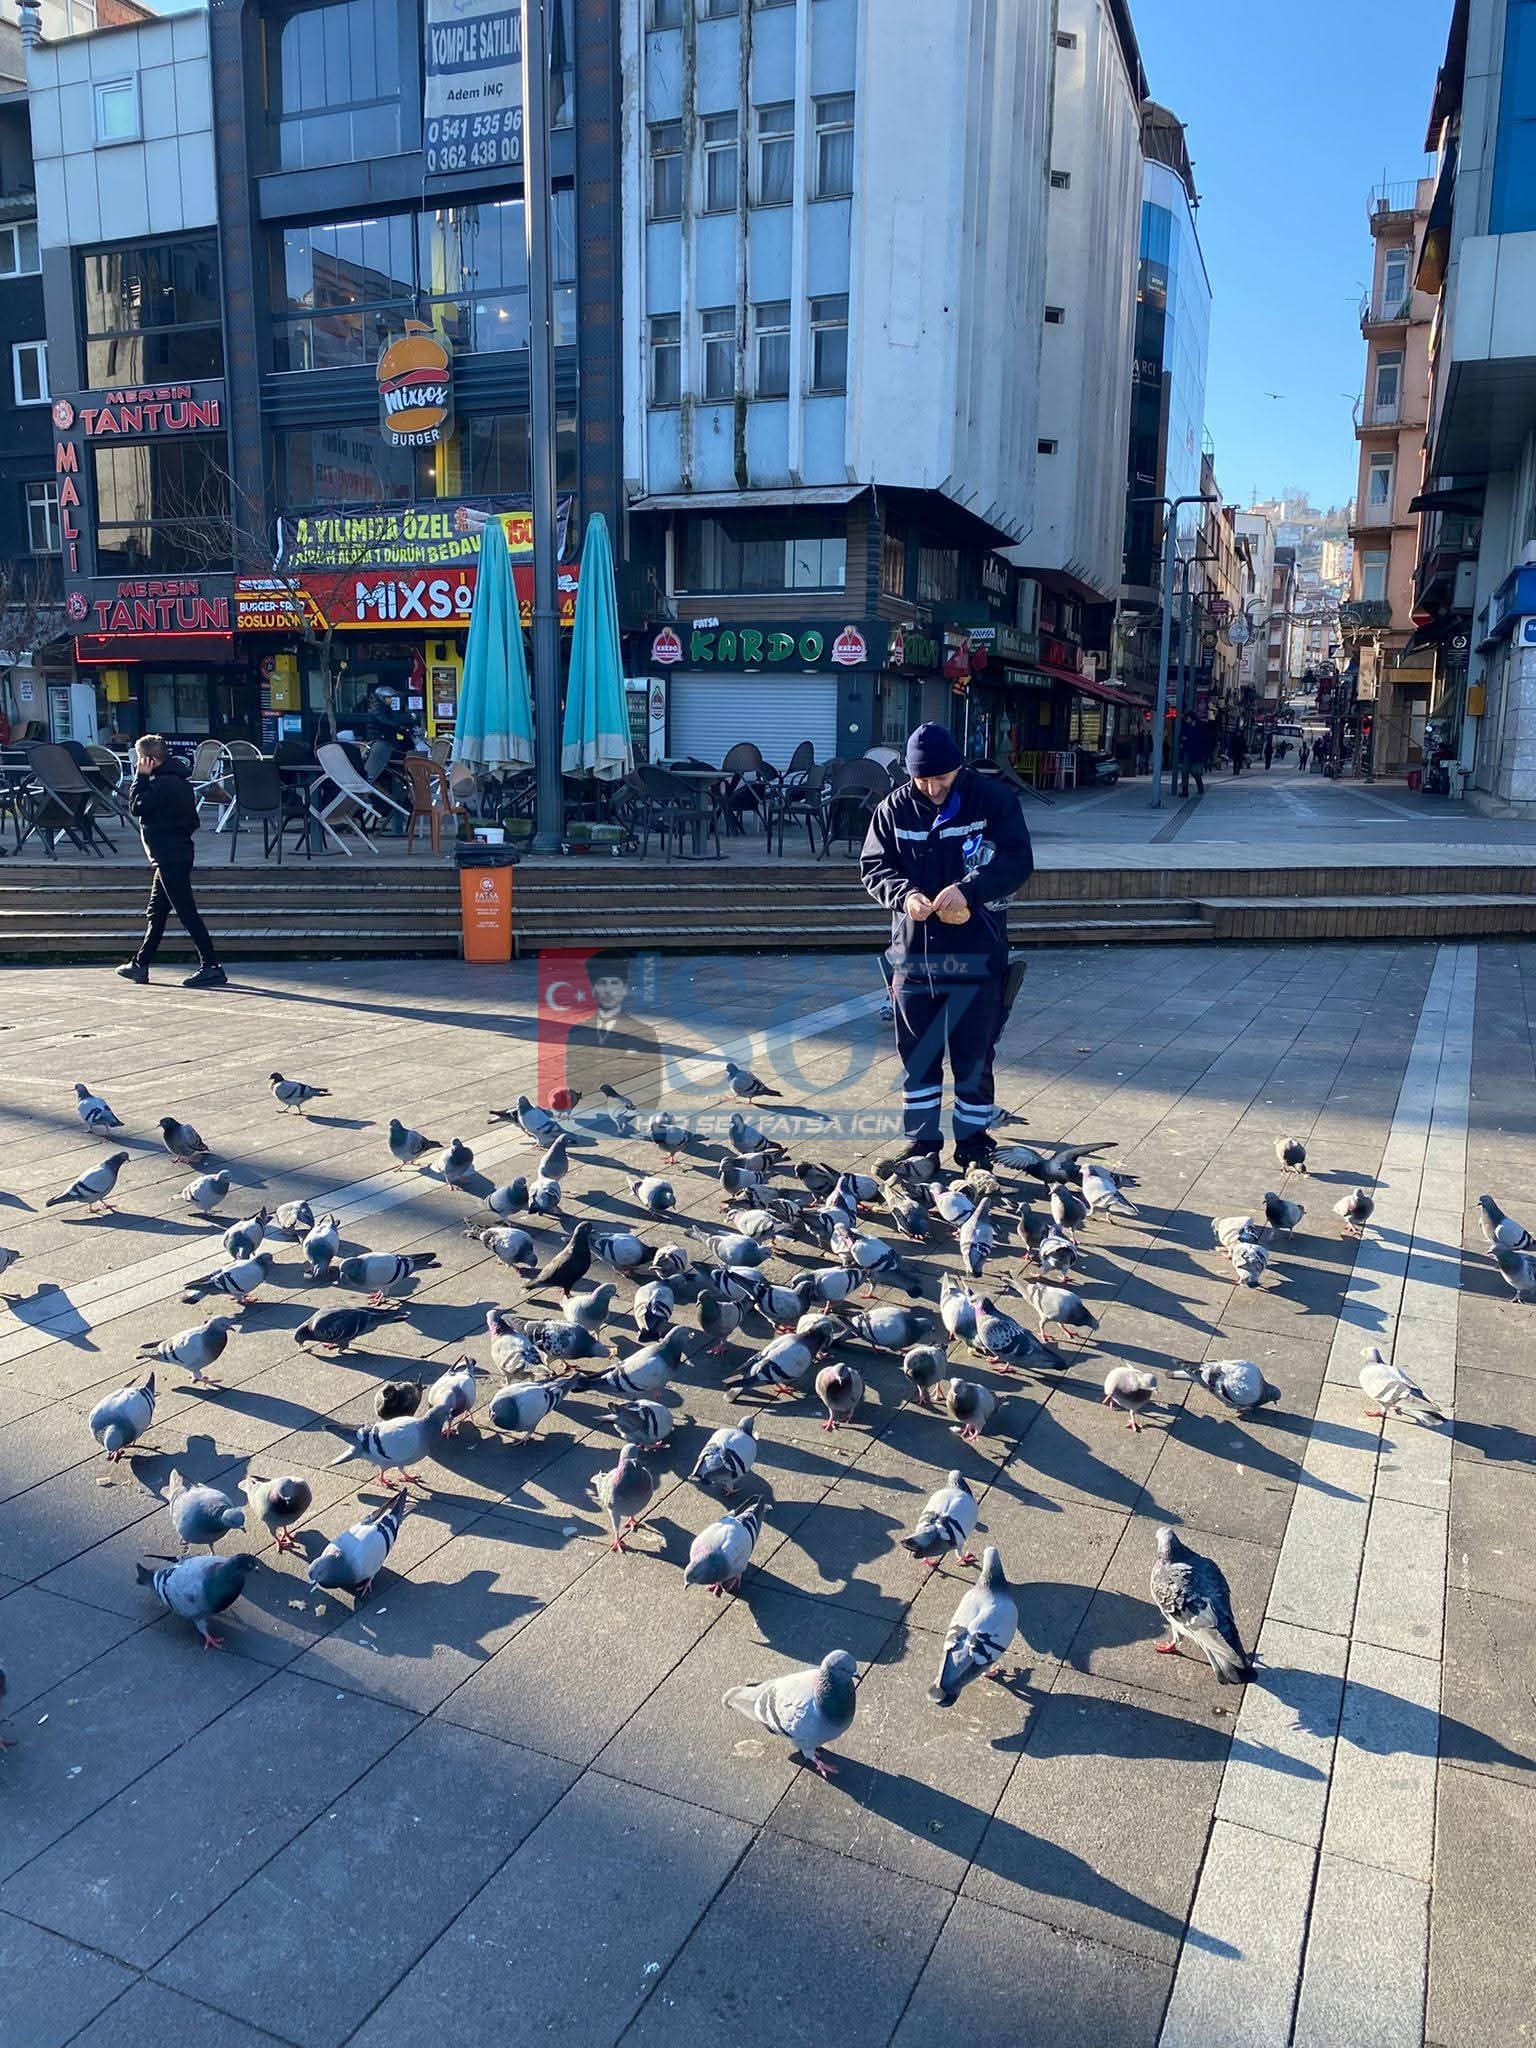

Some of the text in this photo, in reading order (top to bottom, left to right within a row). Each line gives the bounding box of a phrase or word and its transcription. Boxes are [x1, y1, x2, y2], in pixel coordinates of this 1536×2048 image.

[432, 15, 521, 65] KOMPLE SATILIK
[447, 82, 503, 101] Adem İNÇ
[428, 109, 522, 143] 0 541 535 96
[427, 136, 519, 171] 0 362 438 00
[392, 429, 440, 445] BURGER
[403, 509, 453, 540] ÖZEL
[384, 543, 425, 563] DÜRÜM
[237, 611, 318, 628] SOSLU DÖNR
[693, 616, 719, 629] FATSA
[690, 629, 823, 662] KARDO
